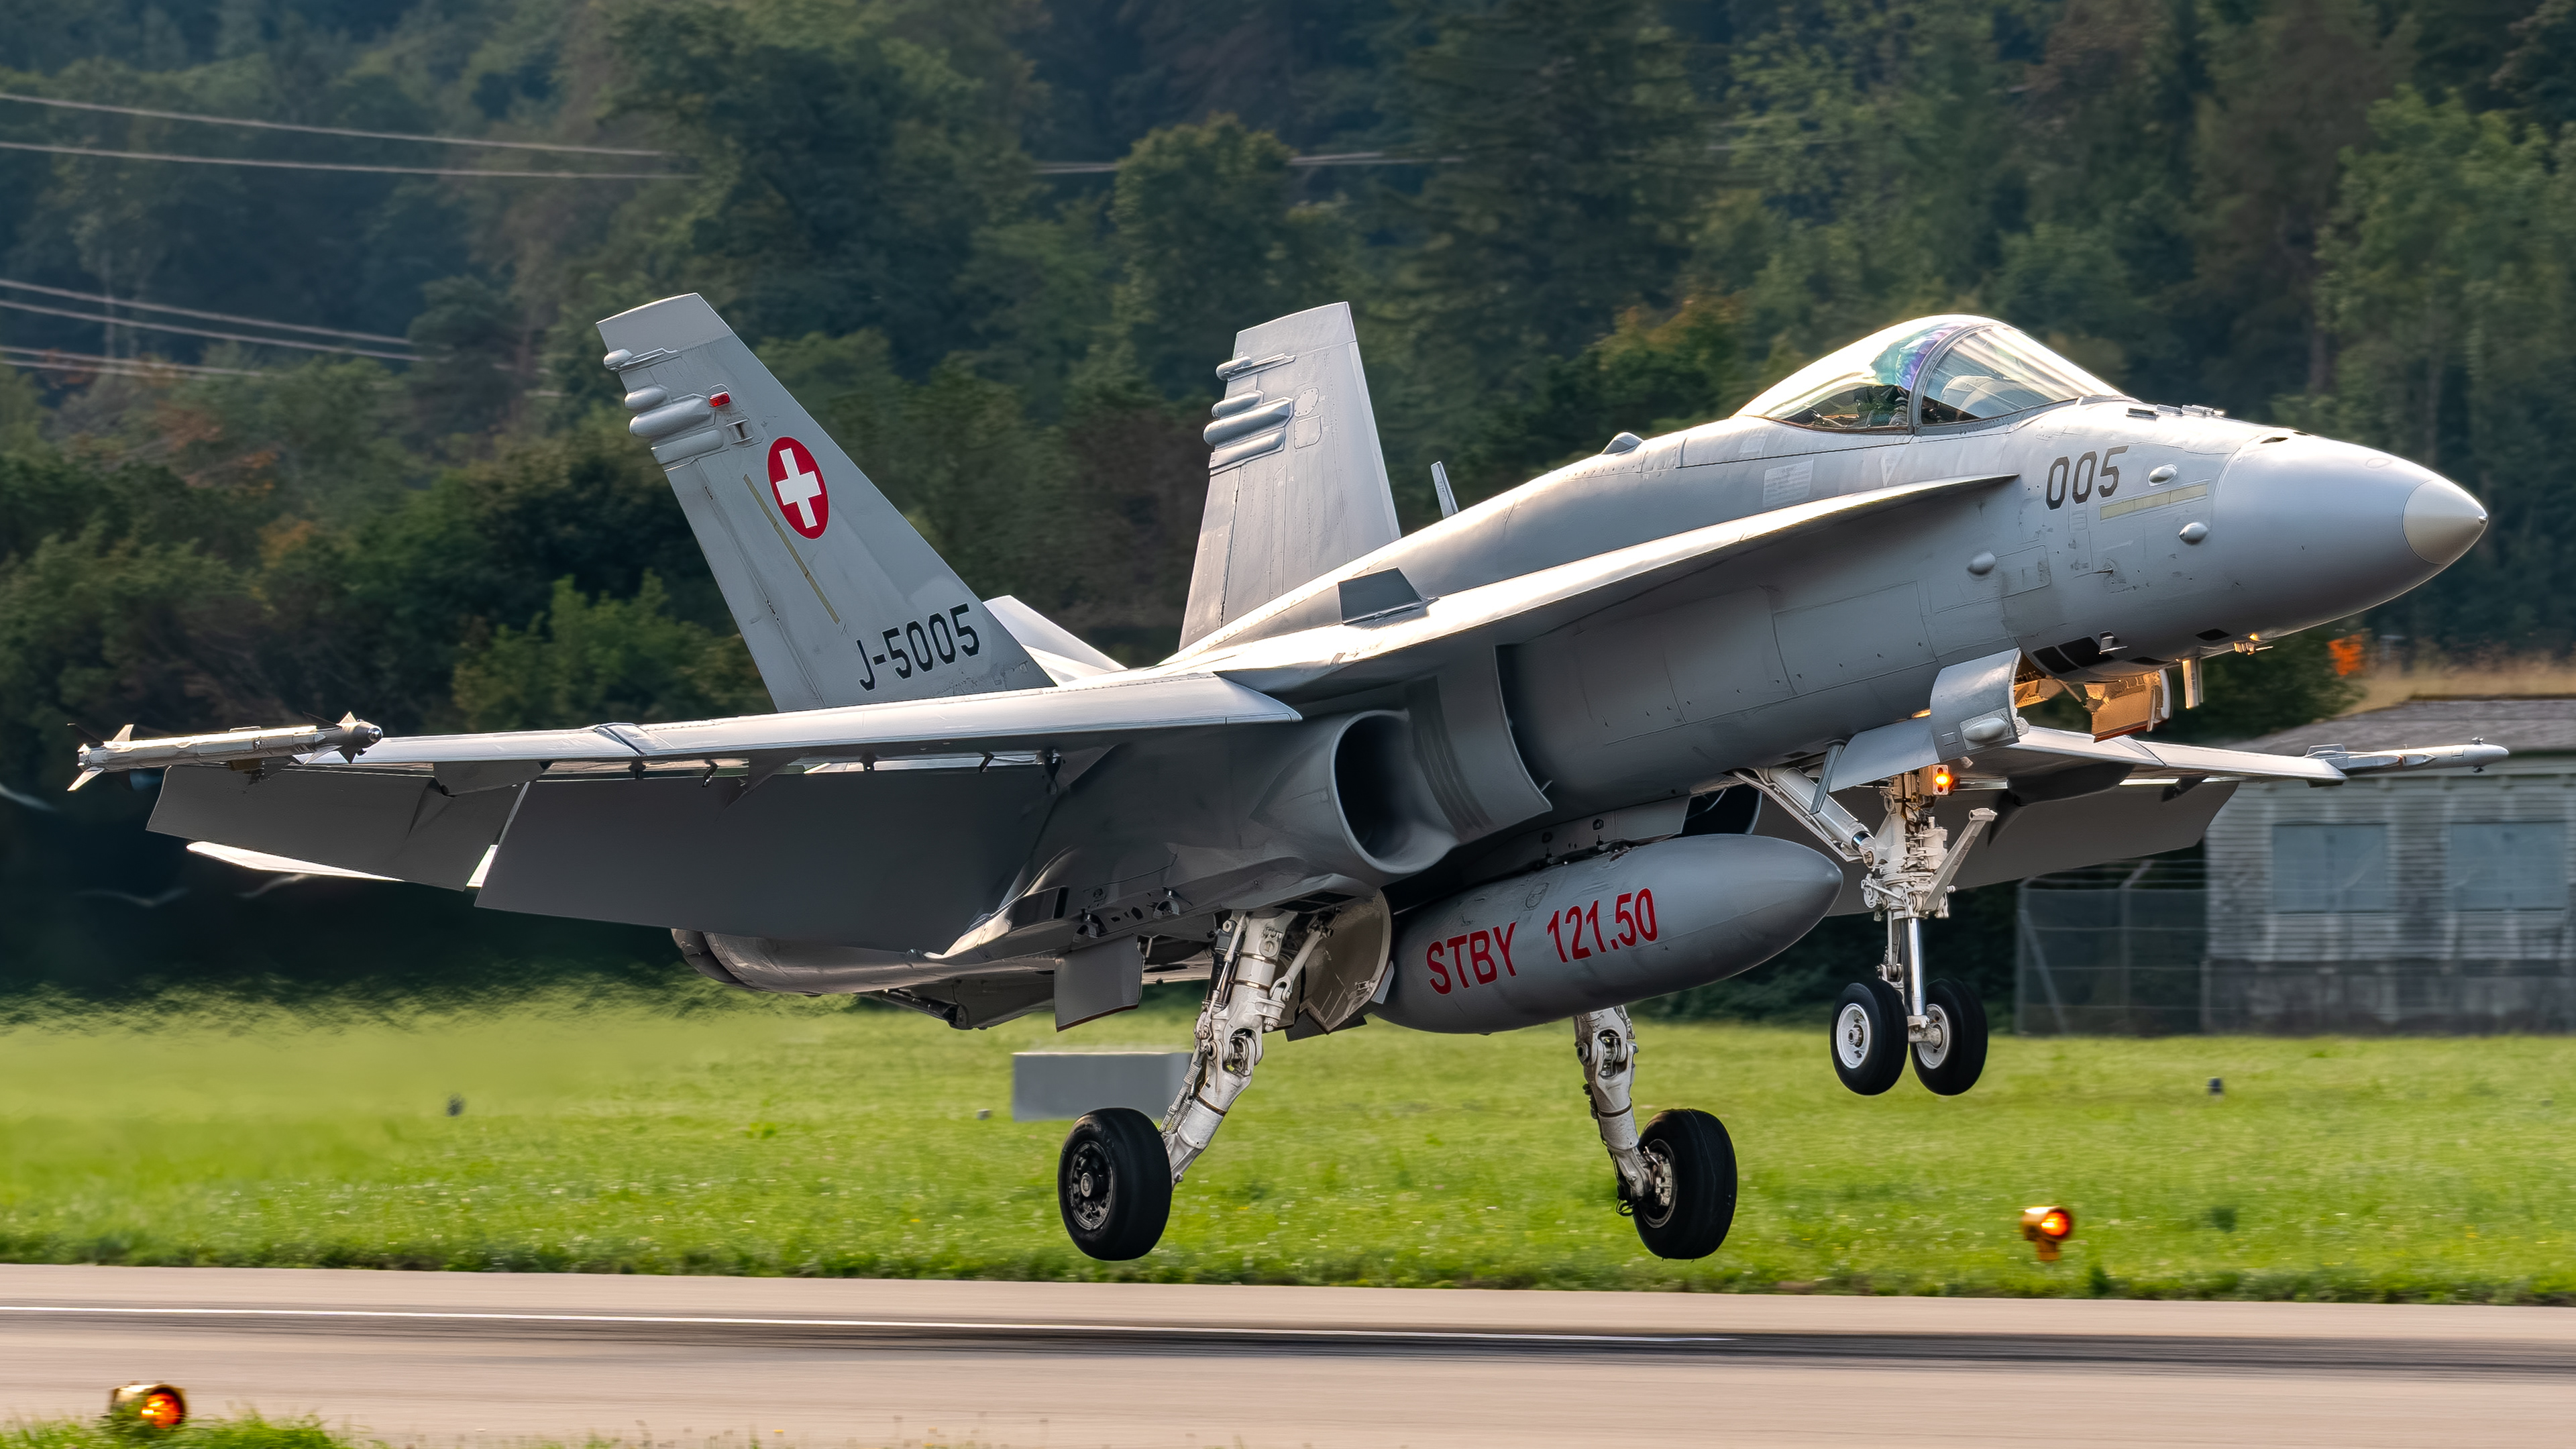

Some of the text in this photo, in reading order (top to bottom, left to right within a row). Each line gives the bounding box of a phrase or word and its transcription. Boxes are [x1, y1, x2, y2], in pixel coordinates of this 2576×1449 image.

[2045, 445, 2129, 511] 005
[856, 603, 979, 691] J-5005
[1426, 888, 1658, 995] STBY 121.50
